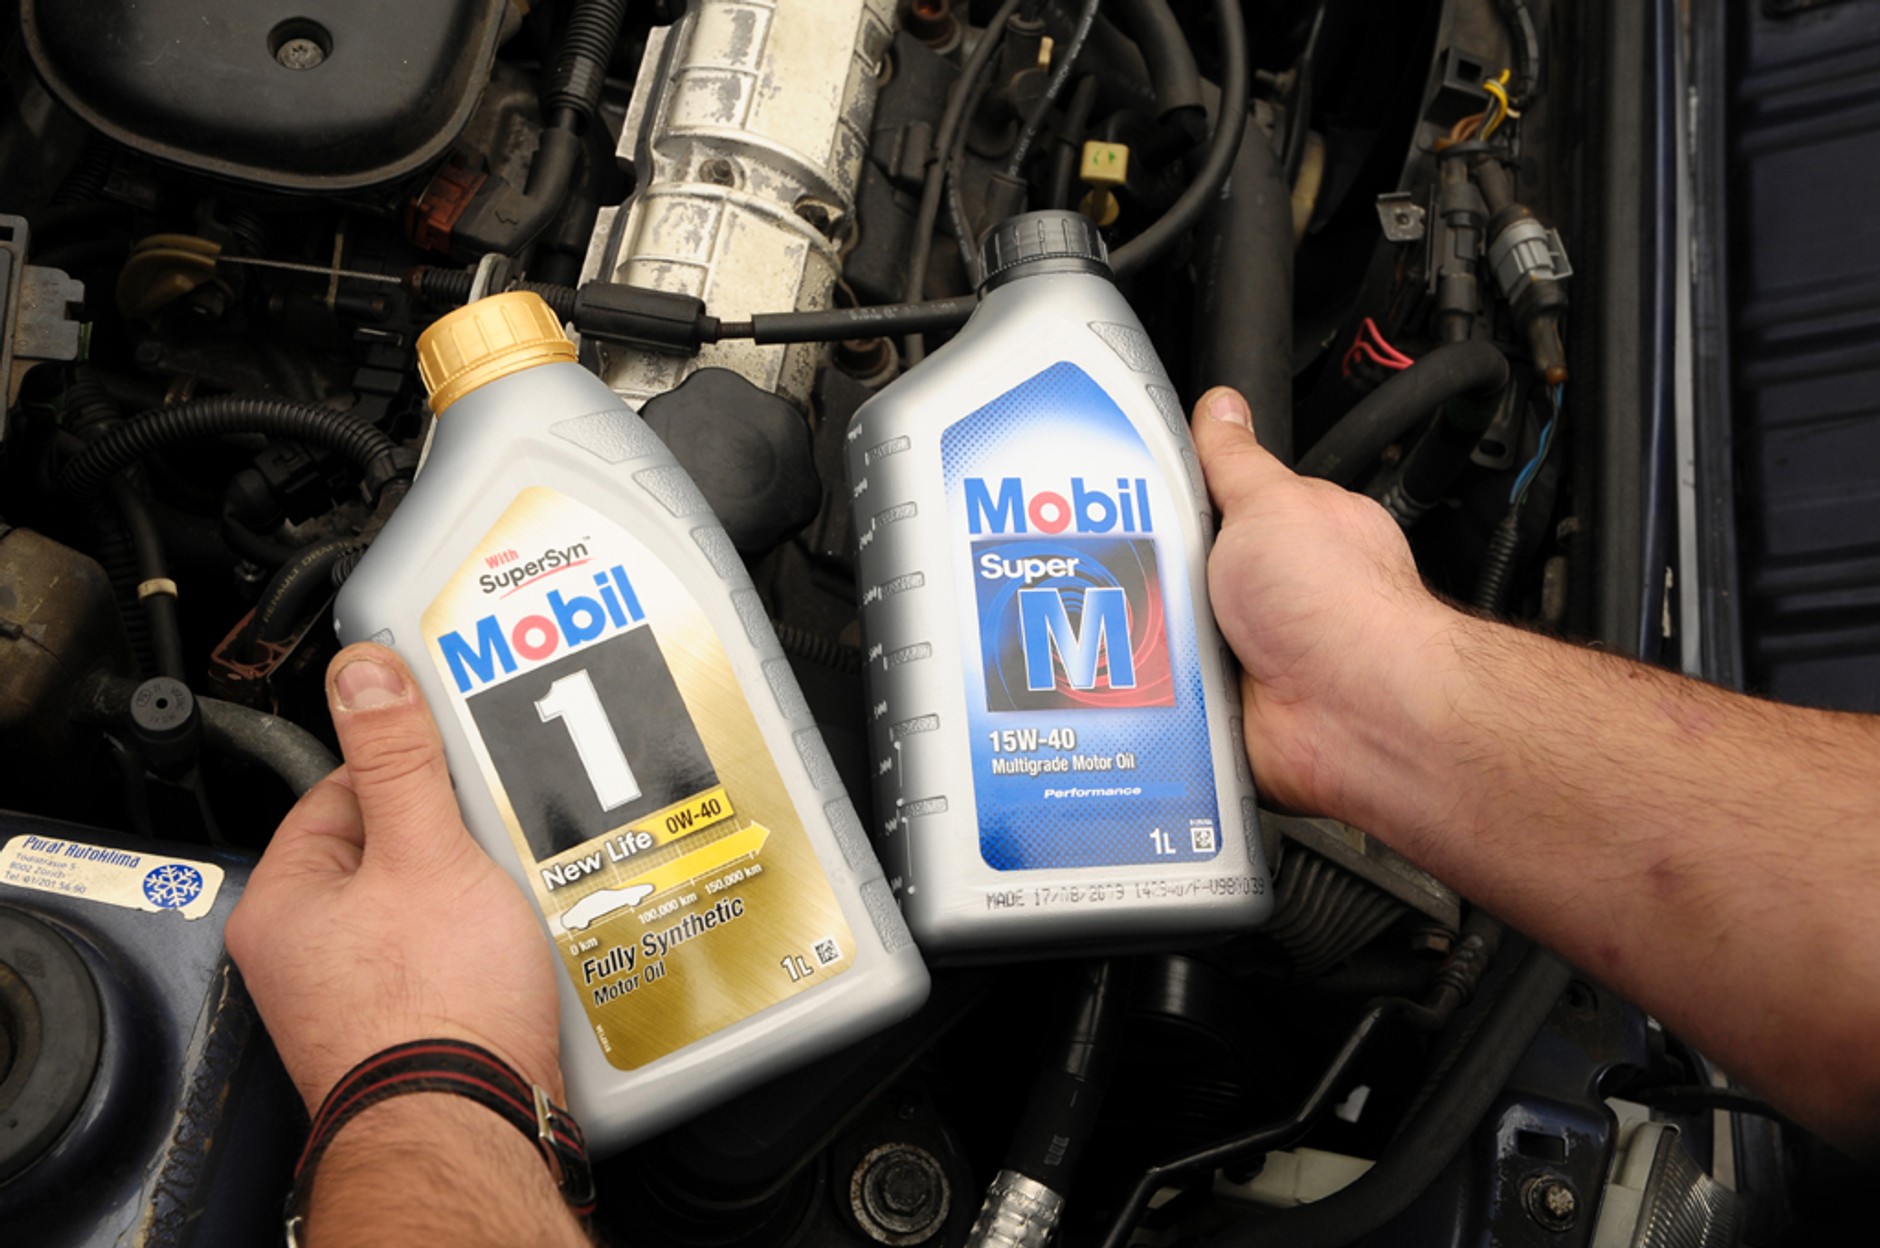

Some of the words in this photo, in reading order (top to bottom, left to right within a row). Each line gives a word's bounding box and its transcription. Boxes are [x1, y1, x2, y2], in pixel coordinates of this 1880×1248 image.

[964, 477, 1153, 535] Mobil
[484, 549, 519, 569] With
[980, 553, 1079, 584] Super
[438, 564, 645, 693] Mobil
[1017, 587, 1137, 693] M
[534, 668, 642, 813] 1
[988, 727, 1076, 753] 15W-40
[992, 756, 1069, 776] Multigrade
[1072, 755, 1113, 771] Motor
[1116, 753, 1135, 769] Oil
[1044, 786, 1142, 799] Performance
[666, 798, 722, 835] 0W-40
[1150, 827, 1176, 854] 1L
[541, 850, 602, 891] New
[604, 829, 653, 863] Life
[704, 868, 745, 894] 150,000
[746, 862, 763, 877] km
[638, 900, 680, 924] 100,000
[680, 891, 698, 906] km
[986, 888, 1025, 910] MADE
[570, 944, 578, 956] 0
[579, 936, 598, 951] km
[582, 944, 636, 984] Fully
[642, 897, 745, 957] Synthetic
[593, 975, 639, 1007] Motor
[644, 961, 666, 984] Oil
[781, 954, 814, 983] 1L
